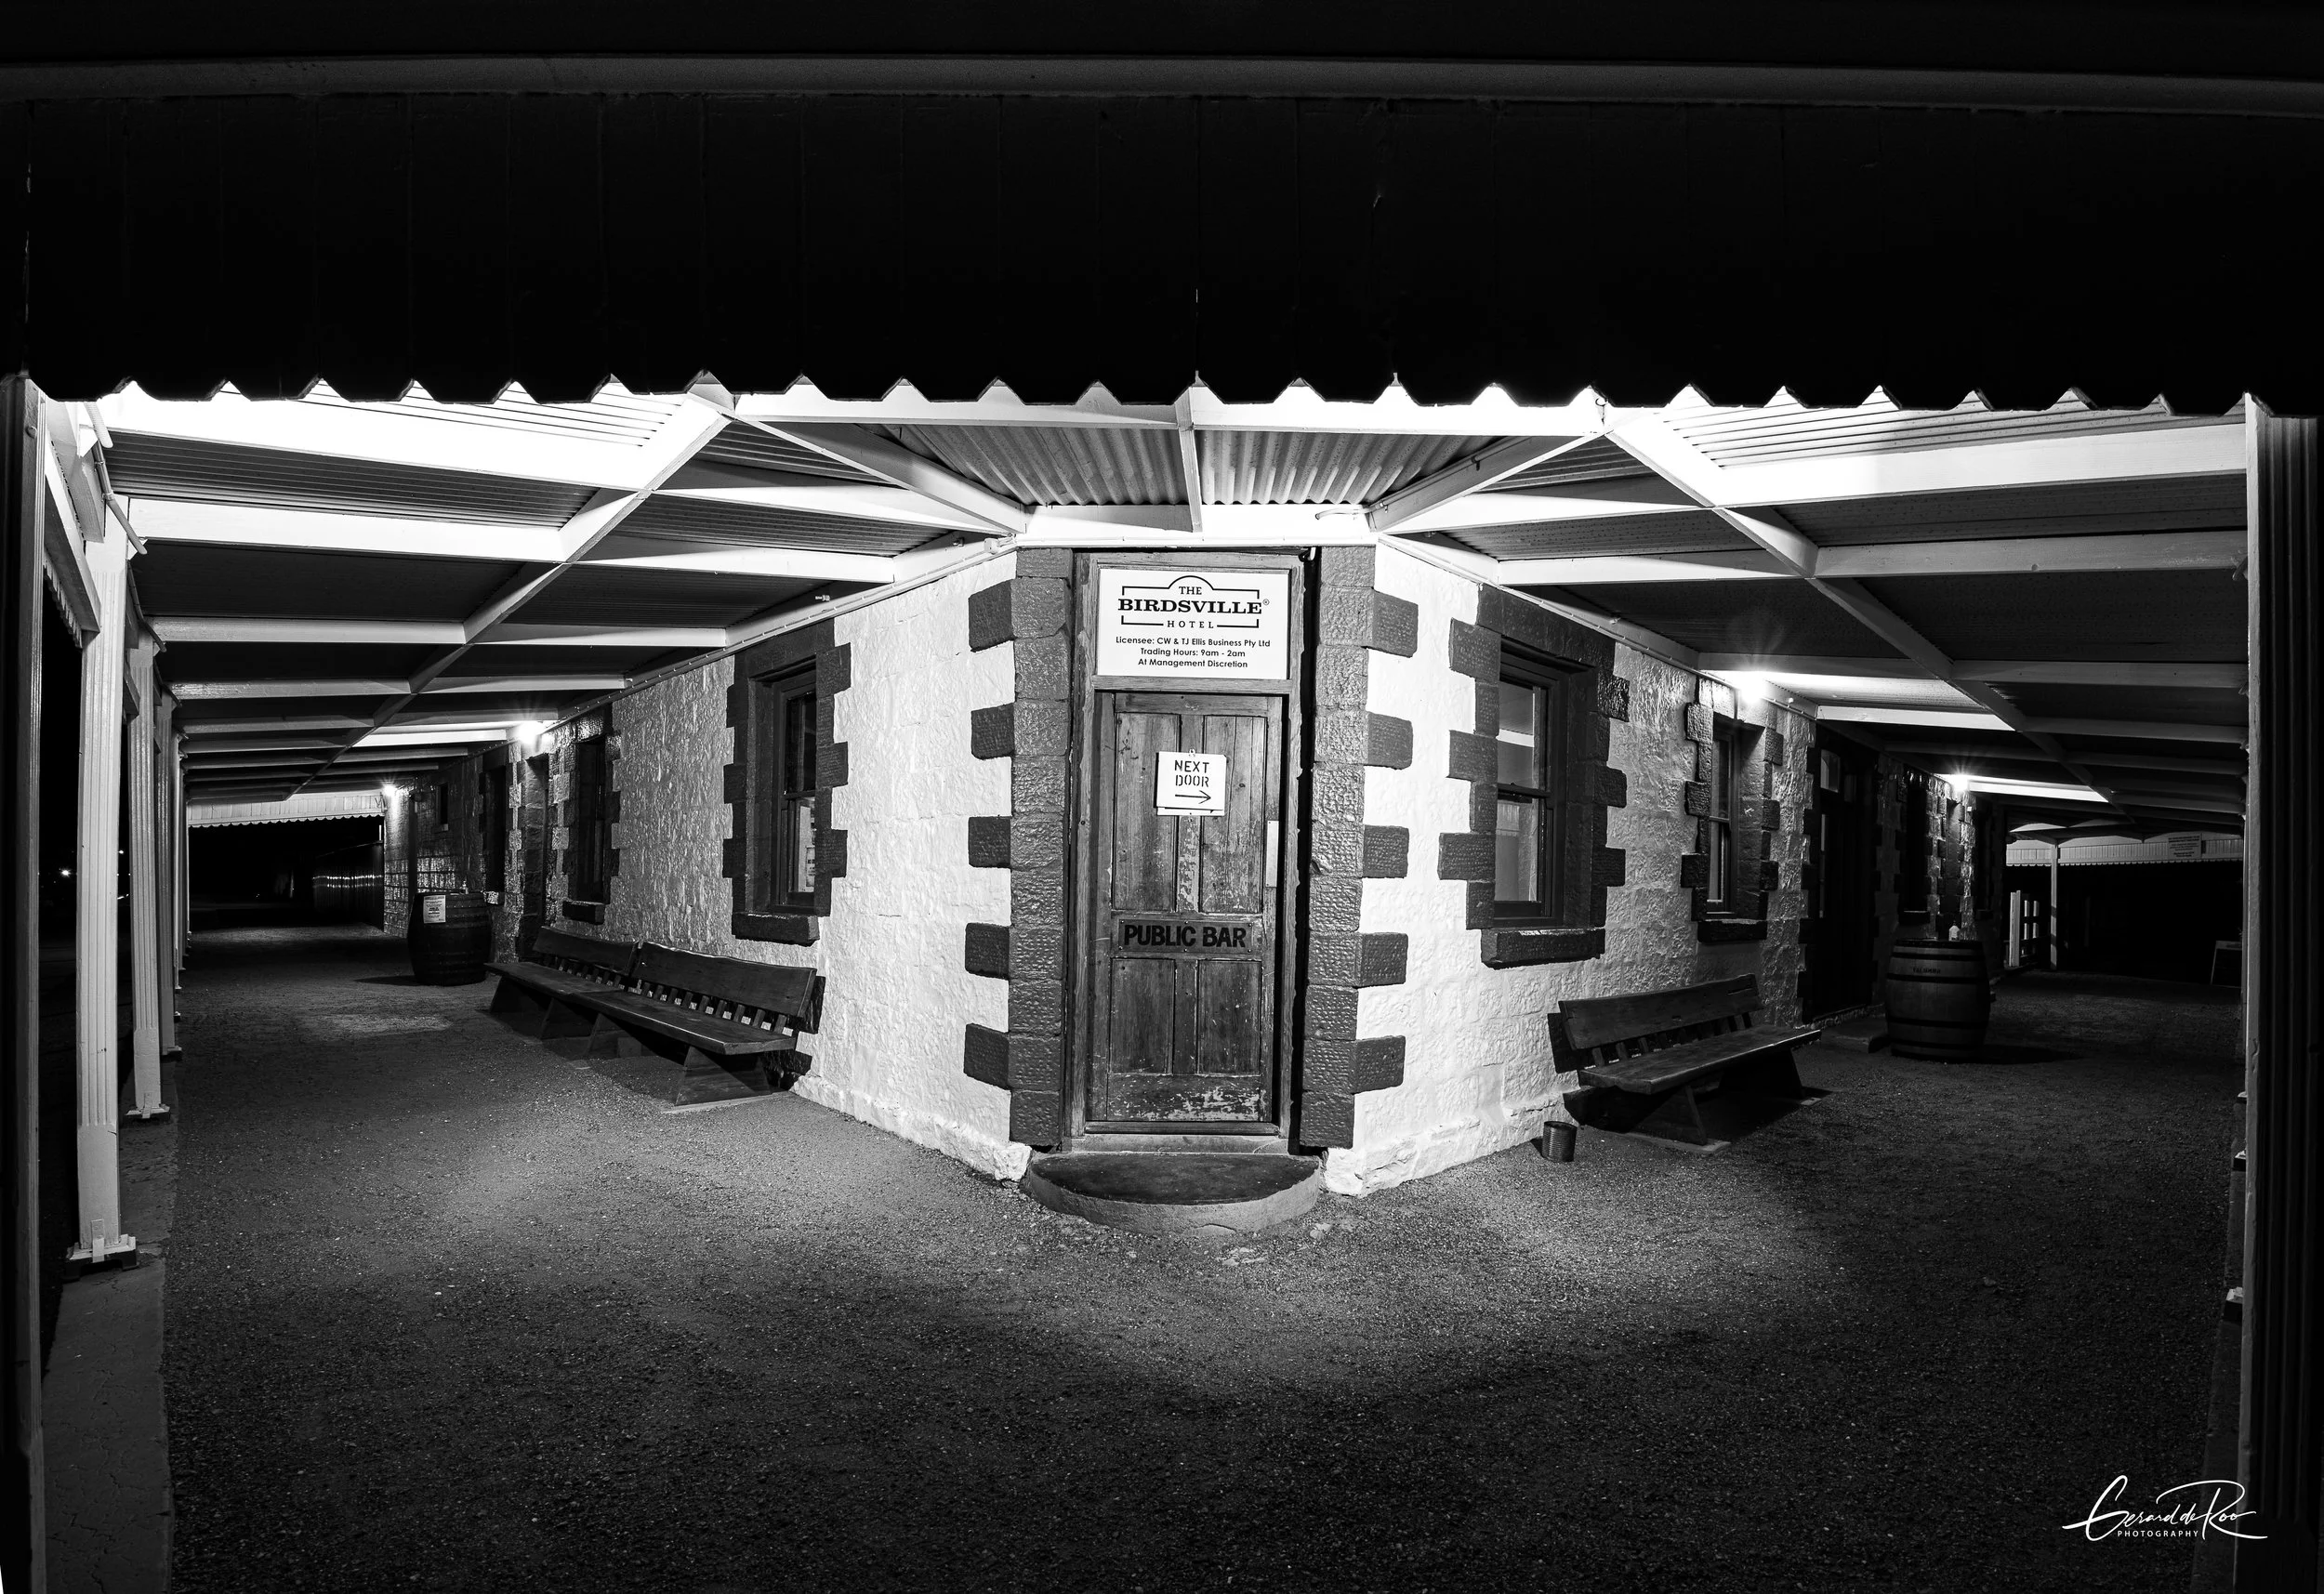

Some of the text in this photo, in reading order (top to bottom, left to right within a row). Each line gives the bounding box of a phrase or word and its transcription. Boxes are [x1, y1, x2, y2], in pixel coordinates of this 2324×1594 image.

[1178, 586, 1202, 595] THE
[1118, 599, 1262, 614] BIRDSVILLE
[1167, 620, 1214, 629] HOTEL
[1116, 636, 1155, 645] Licensee:
[1156, 637, 1171, 645] CW
[1181, 638, 1190, 646] TJ
[1191, 638, 1207, 646] Ellis
[1208, 639, 1242, 647] Business
[1244, 639, 1257, 649] Pty
[1258, 639, 1271, 648] Ltd
[1141, 647, 1171, 657] Trading
[1173, 648, 1199, 656] Hours:
[1200, 649, 1220, 657] 9am
[1226, 649, 1246, 657] 2am
[1149, 658, 1206, 668] Management
[1208, 659, 1248, 668] Discretion
[1174, 760, 1210, 773] NEXT
[1175, 774, 1209, 788] DOOR
[1124, 924, 1247, 948] PUBLIC BAR
